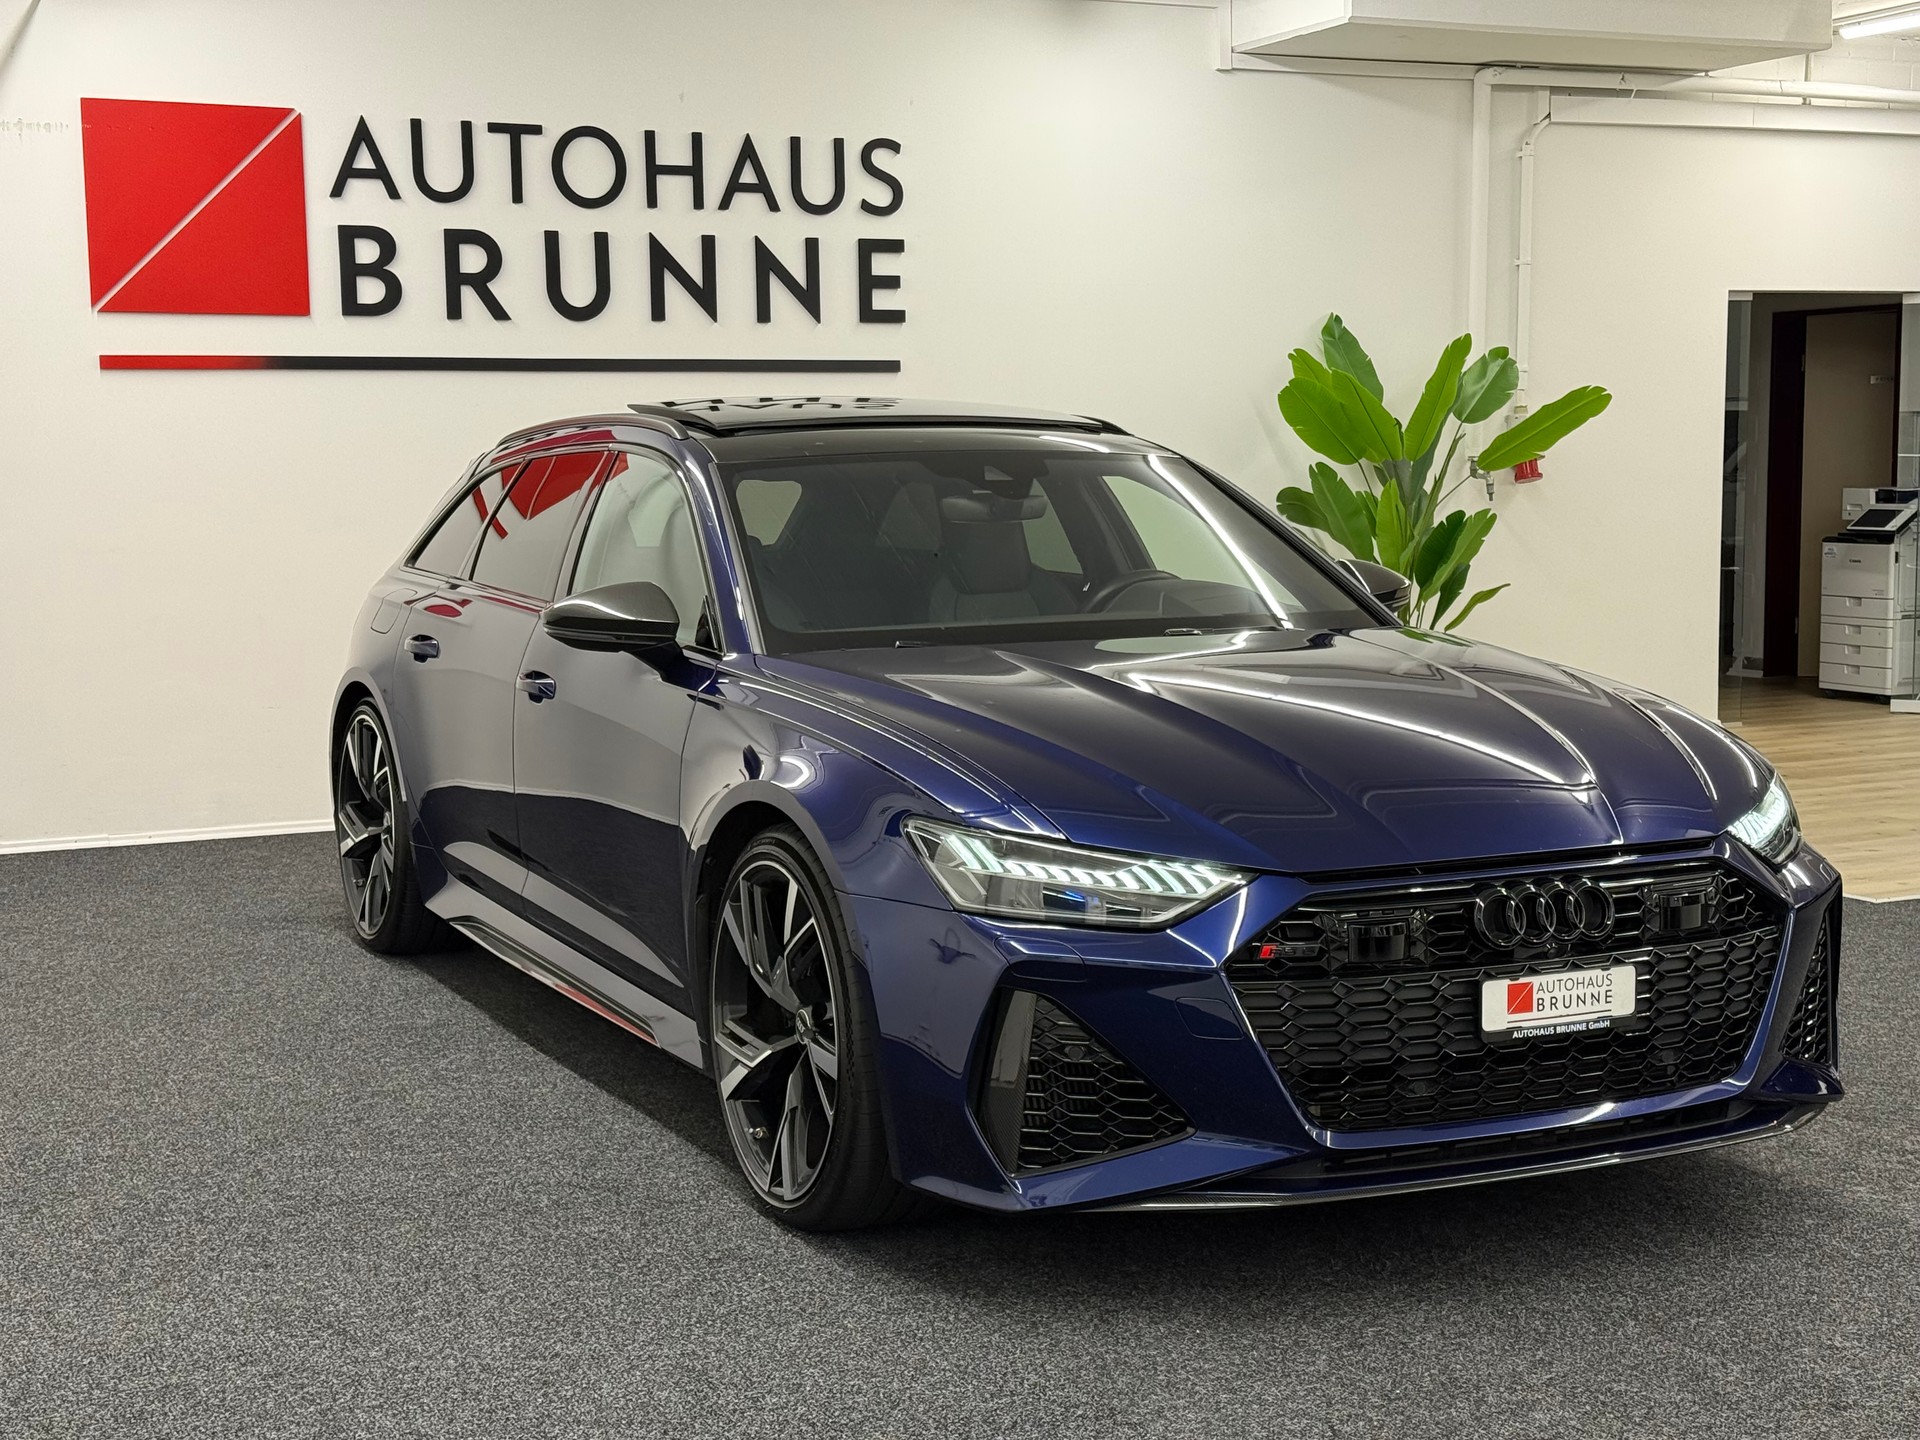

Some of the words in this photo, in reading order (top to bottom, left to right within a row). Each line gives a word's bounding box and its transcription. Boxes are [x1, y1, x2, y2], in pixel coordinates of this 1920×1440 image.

[329, 114, 905, 217] AUTOHAUS
[337, 224, 907, 324] BRUNNE
[1536, 974, 1613, 994] AUTOHAUS
[1536, 989, 1613, 1012] BRUNNE
[1512, 1027, 1555, 1039] AUTOHAUS
[1556, 1023, 1587, 1034] BRUNNE
[1588, 1021, 1610, 1030] GmbH
